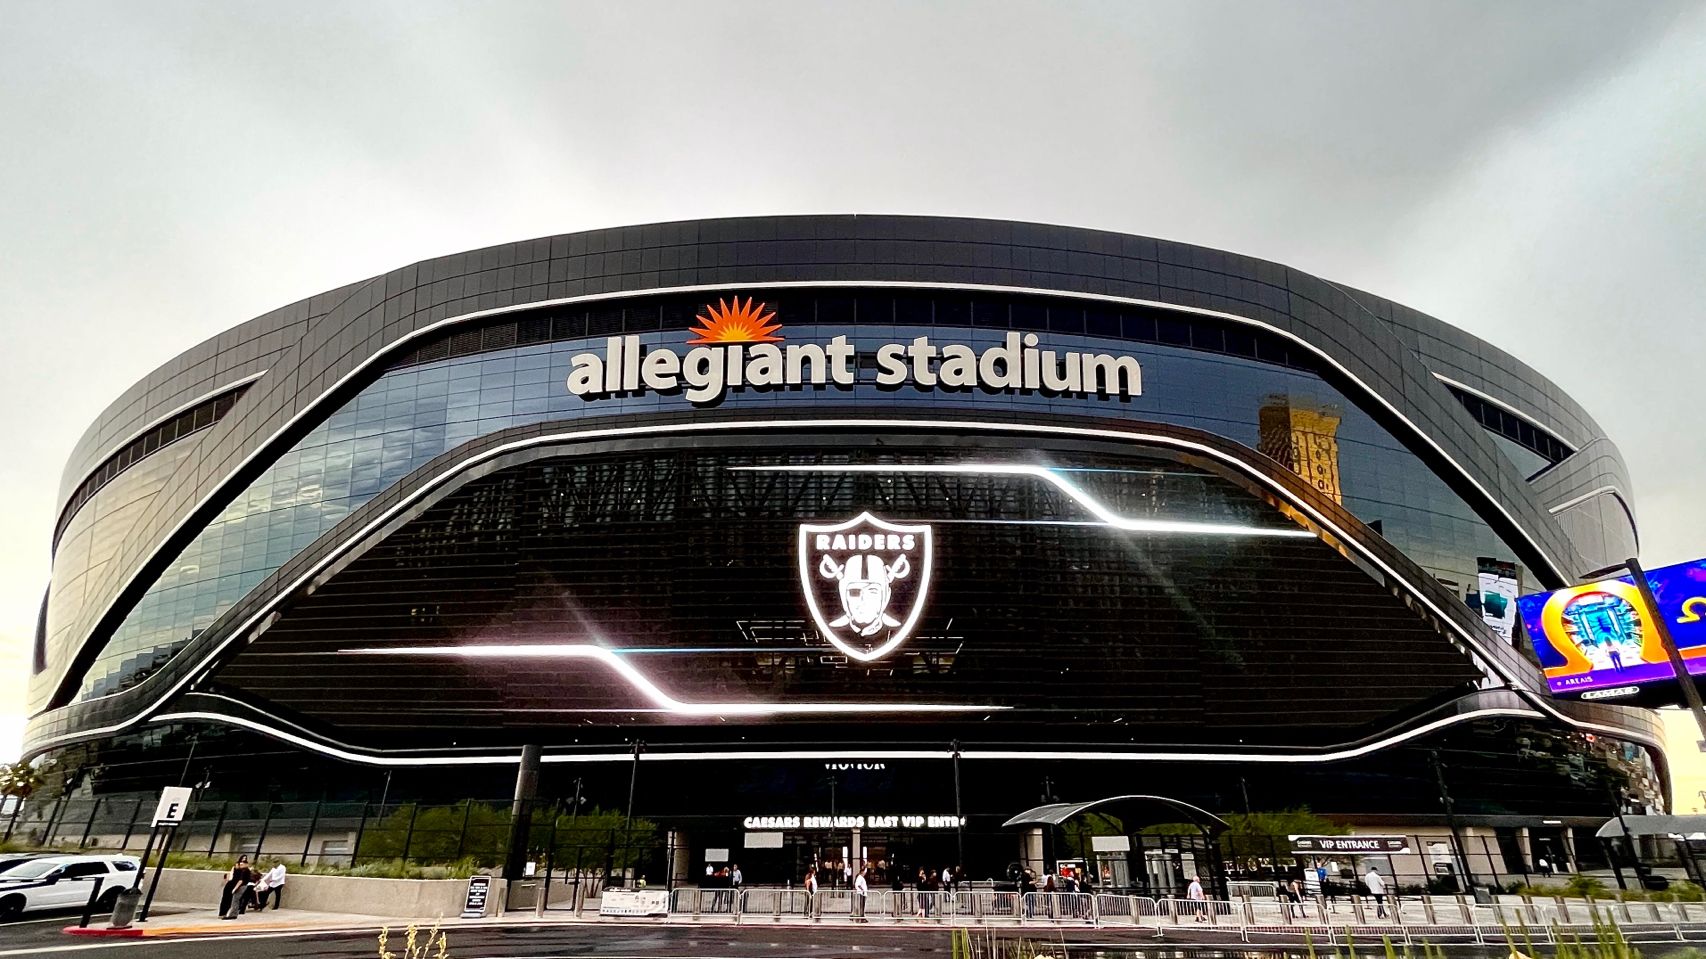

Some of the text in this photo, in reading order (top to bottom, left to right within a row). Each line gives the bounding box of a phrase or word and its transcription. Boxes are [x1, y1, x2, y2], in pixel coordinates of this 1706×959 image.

[566, 331, 1143, 403] allegiant stadium
[816, 534, 915, 550] RAIDERS
[166, 803, 179, 819] E
[744, 816, 800, 828] CAESARS
[803, 816, 864, 828] REWARDS
[868, 816, 899, 828] EAST
[901, 816, 925, 828] VIP
[1319, 840, 1335, 849] VIP
[1336, 840, 1380, 849] ENTRANCE
